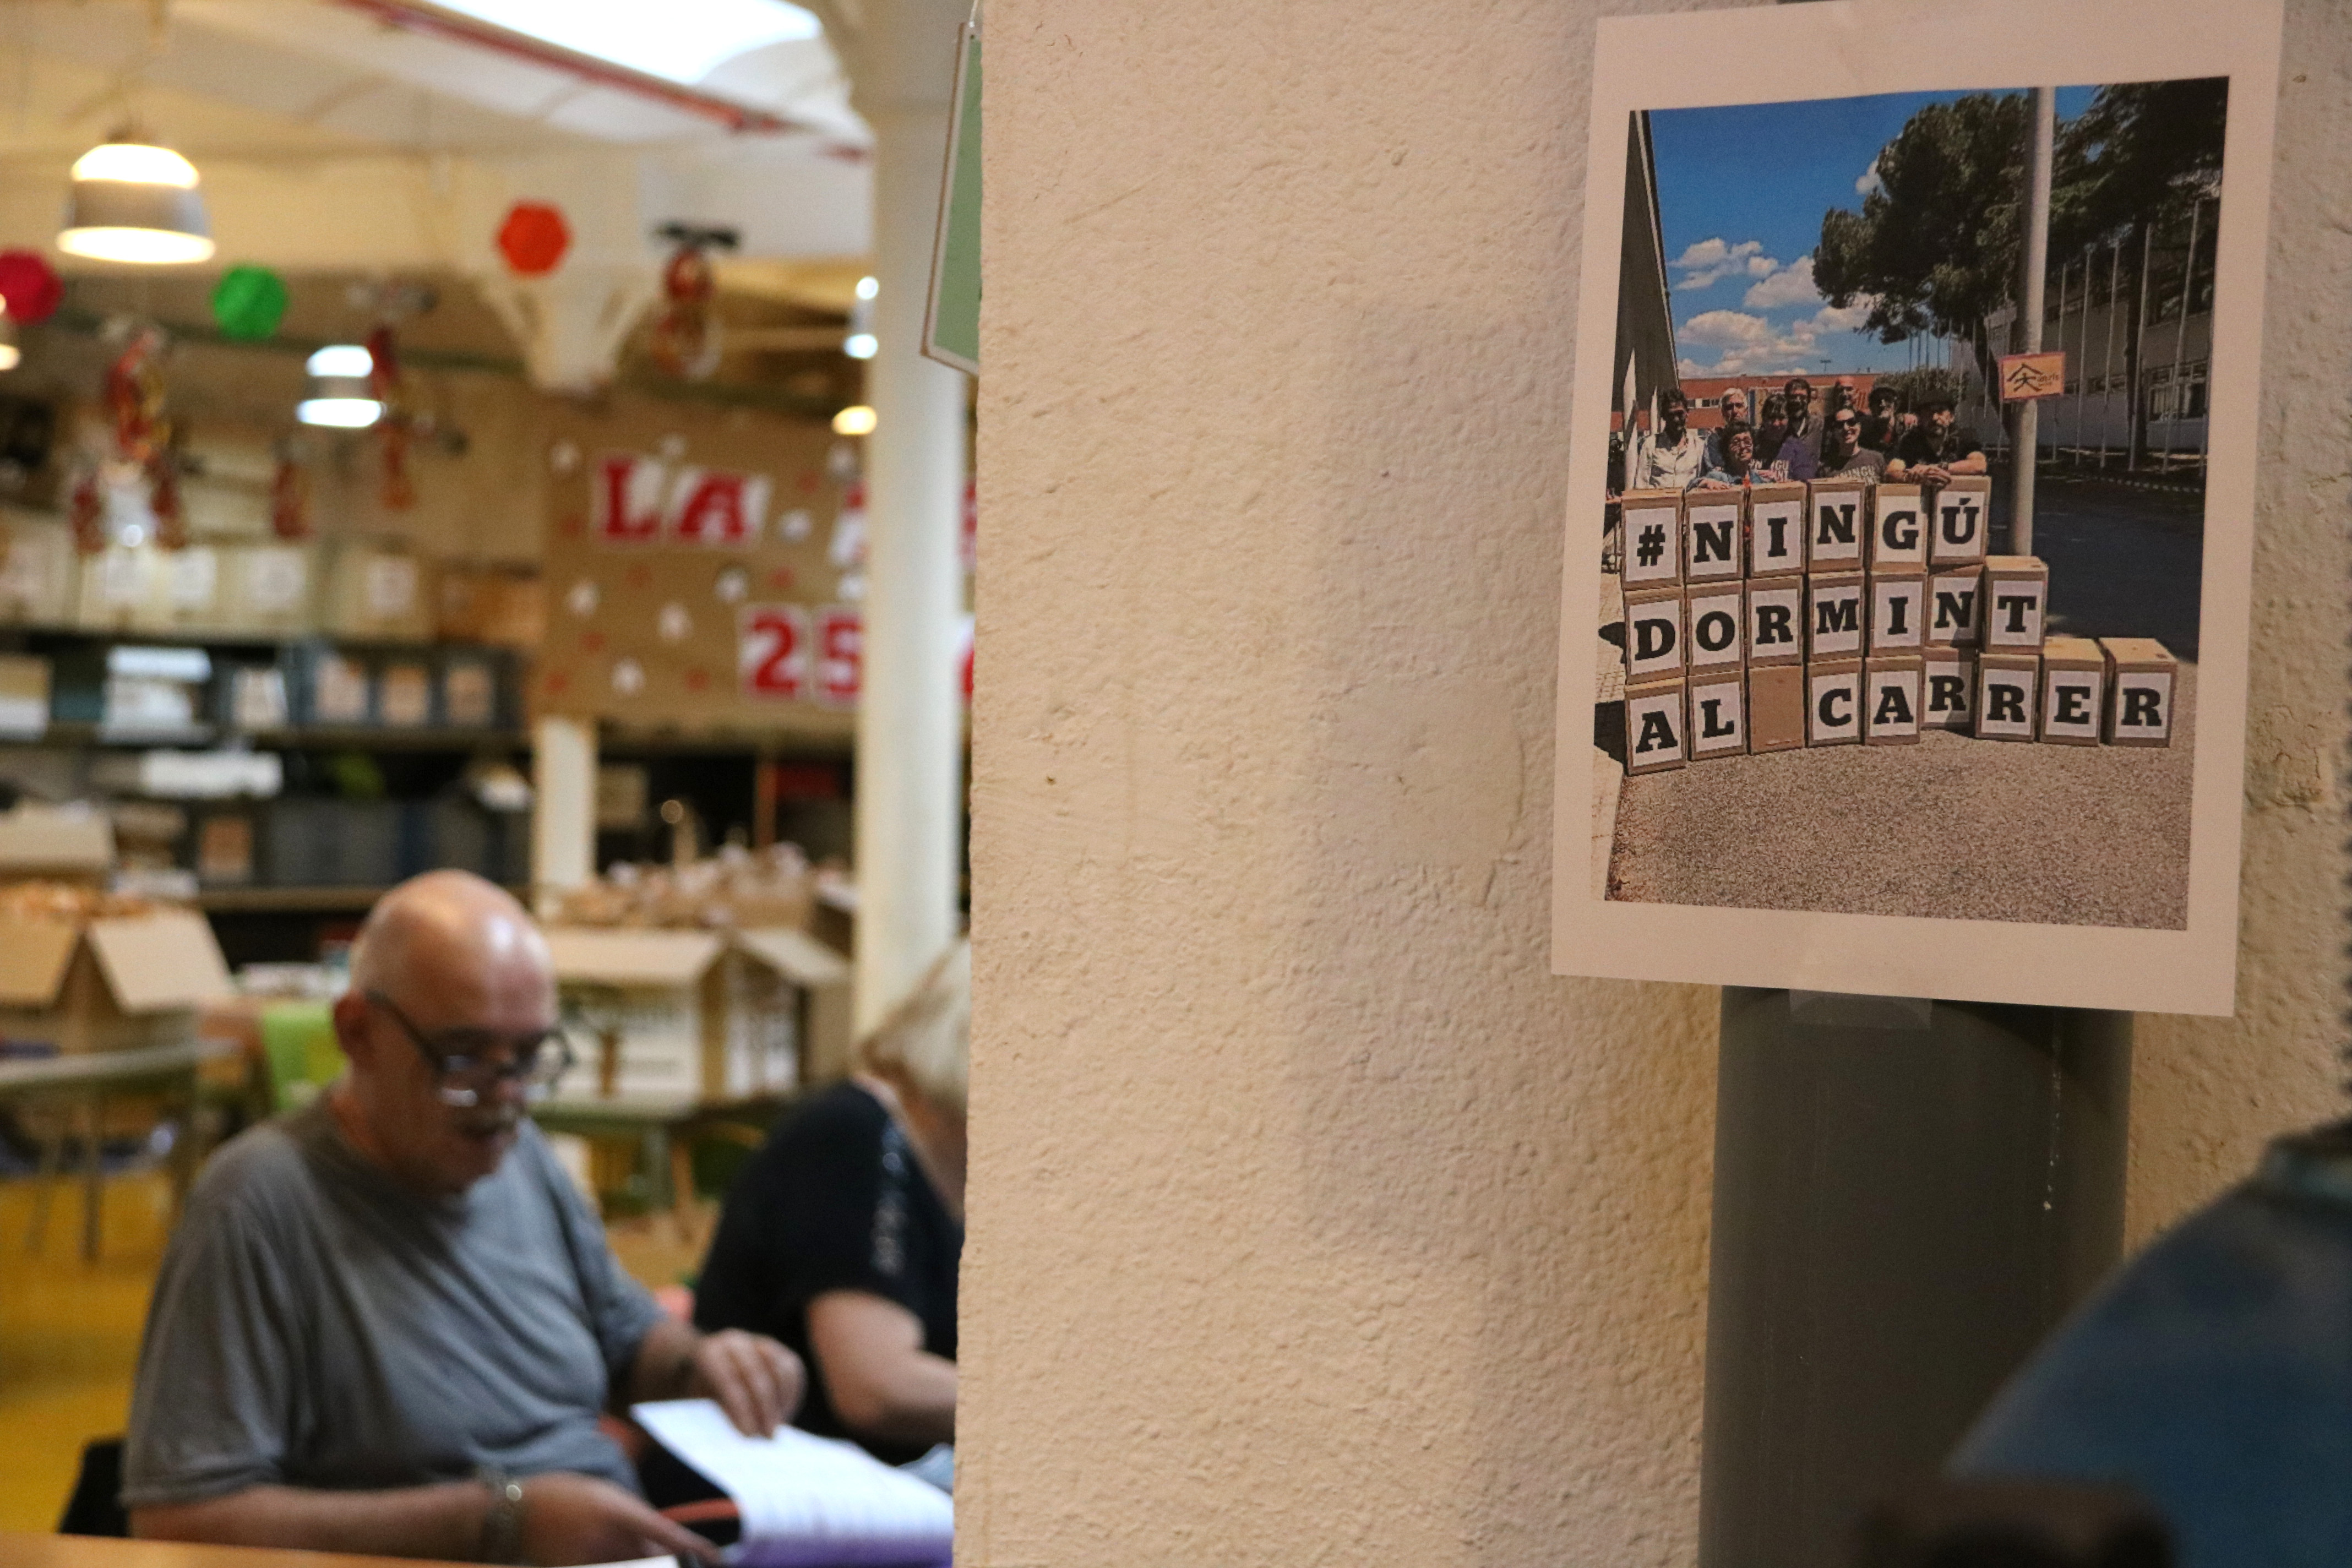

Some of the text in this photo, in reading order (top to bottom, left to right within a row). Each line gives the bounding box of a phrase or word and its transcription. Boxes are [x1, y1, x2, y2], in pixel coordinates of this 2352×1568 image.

[603, 457, 748, 538] LA
[1637, 498, 1979, 567] #NINGÚ
[1634, 591, 2037, 661] DORMINT
[1636, 675, 2163, 754] AL CARRER
